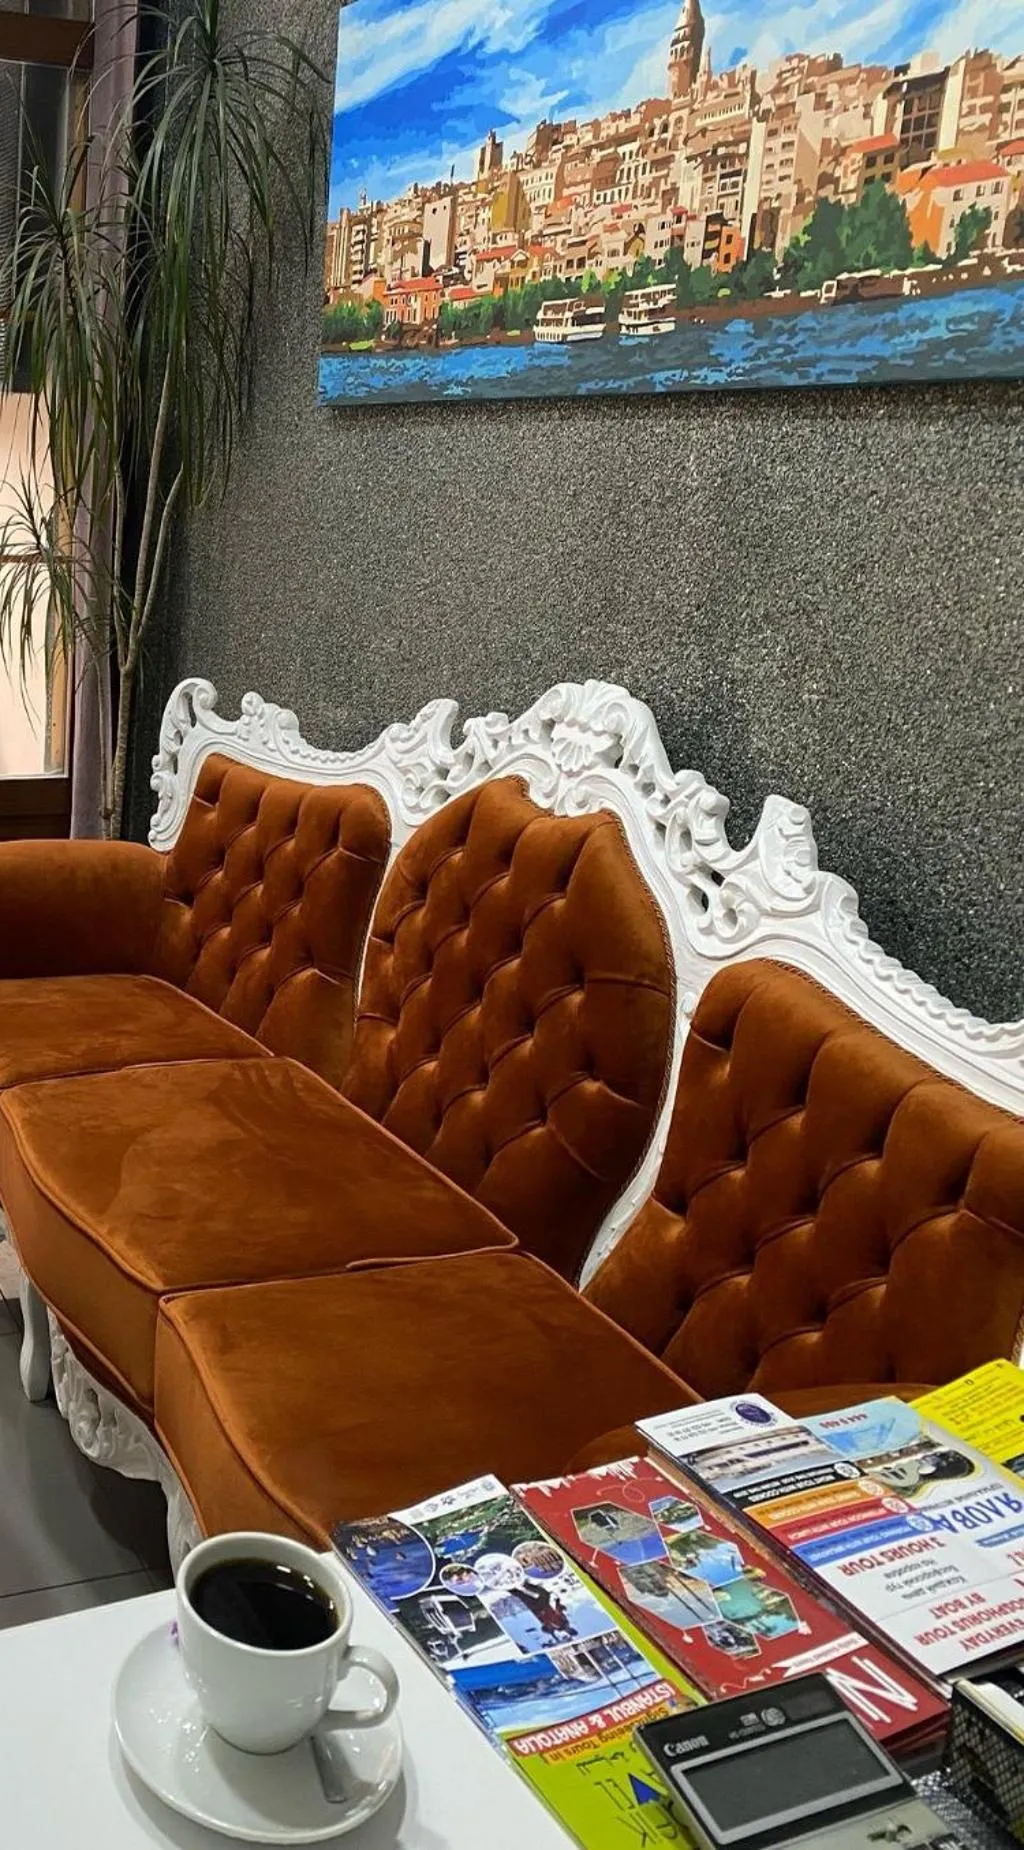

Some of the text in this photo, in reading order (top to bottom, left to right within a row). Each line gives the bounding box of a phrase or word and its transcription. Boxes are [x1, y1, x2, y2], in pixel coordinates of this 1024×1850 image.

[934, 1491, 1023, 1534] ЯЛОВА
[883, 1537, 933, 1567] HOURS
[836, 1553, 882, 1576] TOUR
[929, 1592, 986, 1620] BY BOAT
[915, 1624, 957, 1646] TOUR
[960, 1618, 1024, 1653] EVERYDAY
[590, 1713, 607, 1729] &
[514, 1720, 589, 1754] ANATOLIA
[566, 1738, 600, 1758] Tours
[663, 1735, 710, 1758] Canon
[549, 1749, 566, 1762] in
